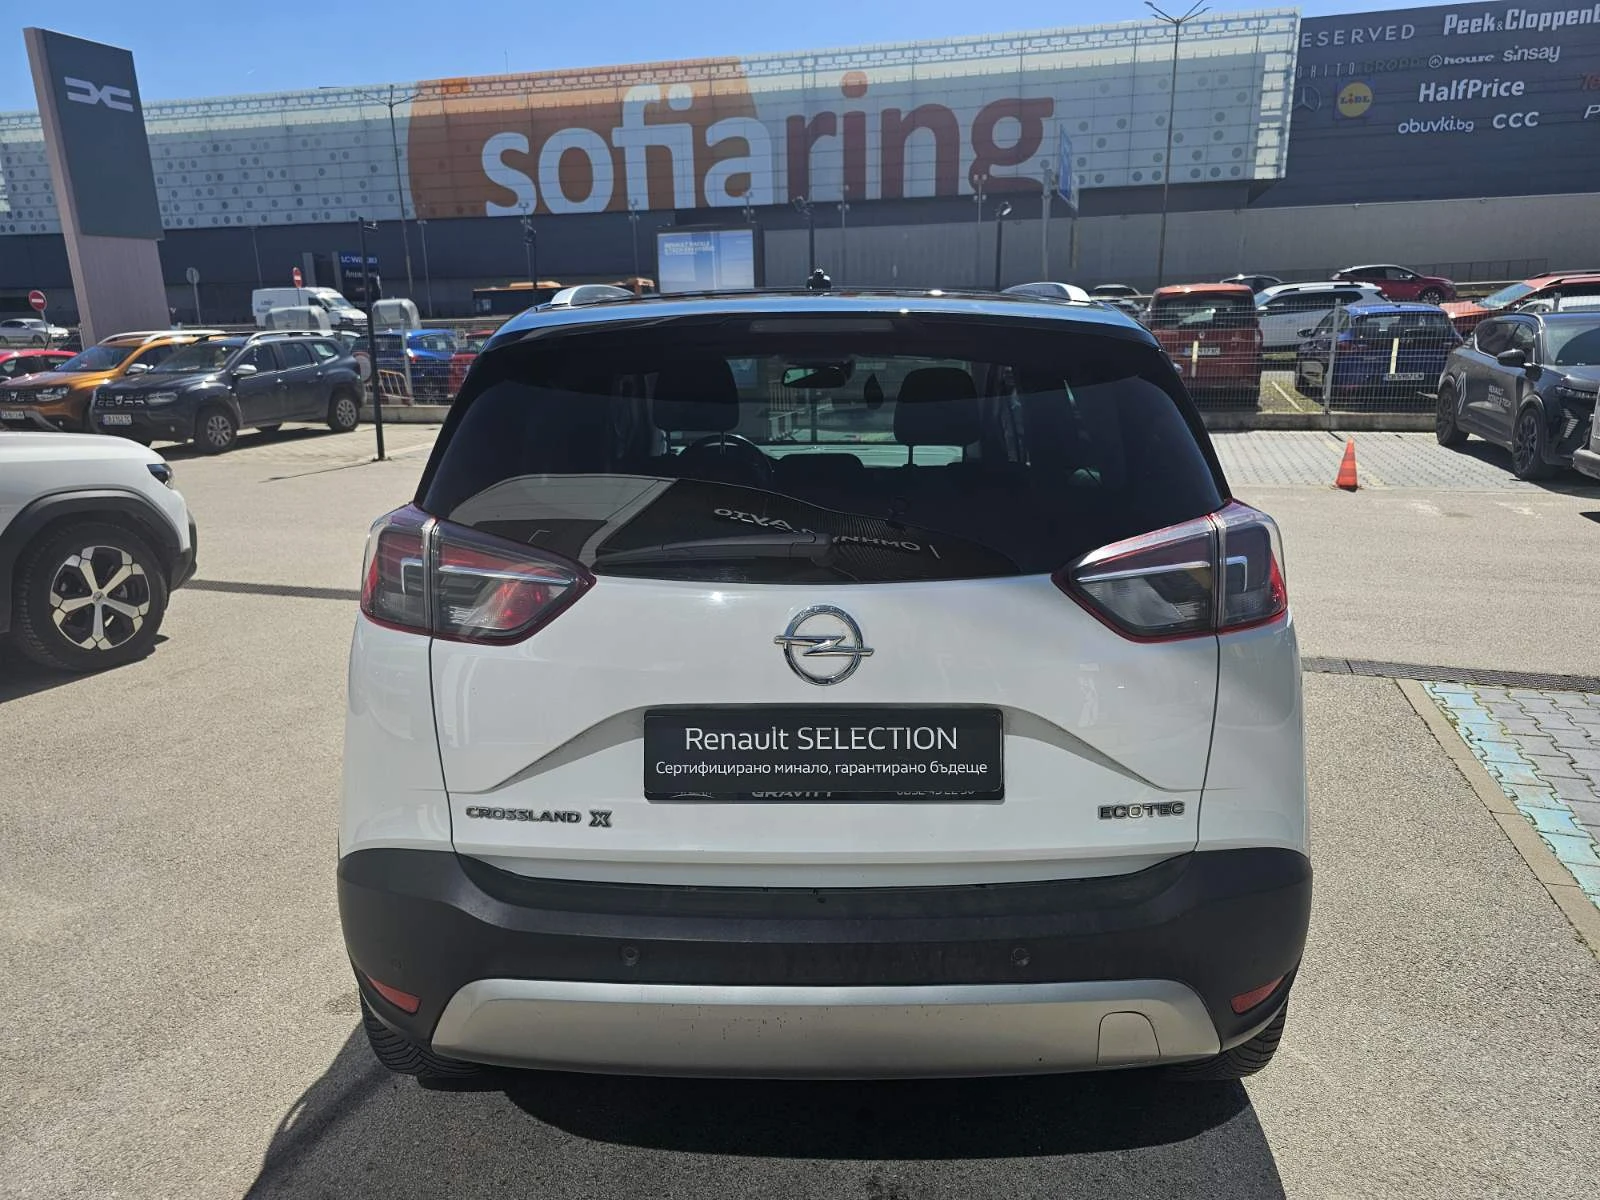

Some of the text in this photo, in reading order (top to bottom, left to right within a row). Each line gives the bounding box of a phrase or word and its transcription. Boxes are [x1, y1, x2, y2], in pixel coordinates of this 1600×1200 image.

[1502, 45, 1561, 63] sinsay
[1418, 79, 1525, 103] HalfPrice
[1397, 115, 1475, 134] obuvki.bg
[1492, 111, 1540, 129] CCC
[684, 726, 958, 751] Renault SELECTION
[656, 760, 988, 777] Сертифицирано минало, гарантирано бъдеще
[465, 806, 613, 828] CROSSLAND X
[1098, 801, 1185, 820] ECOTEC
